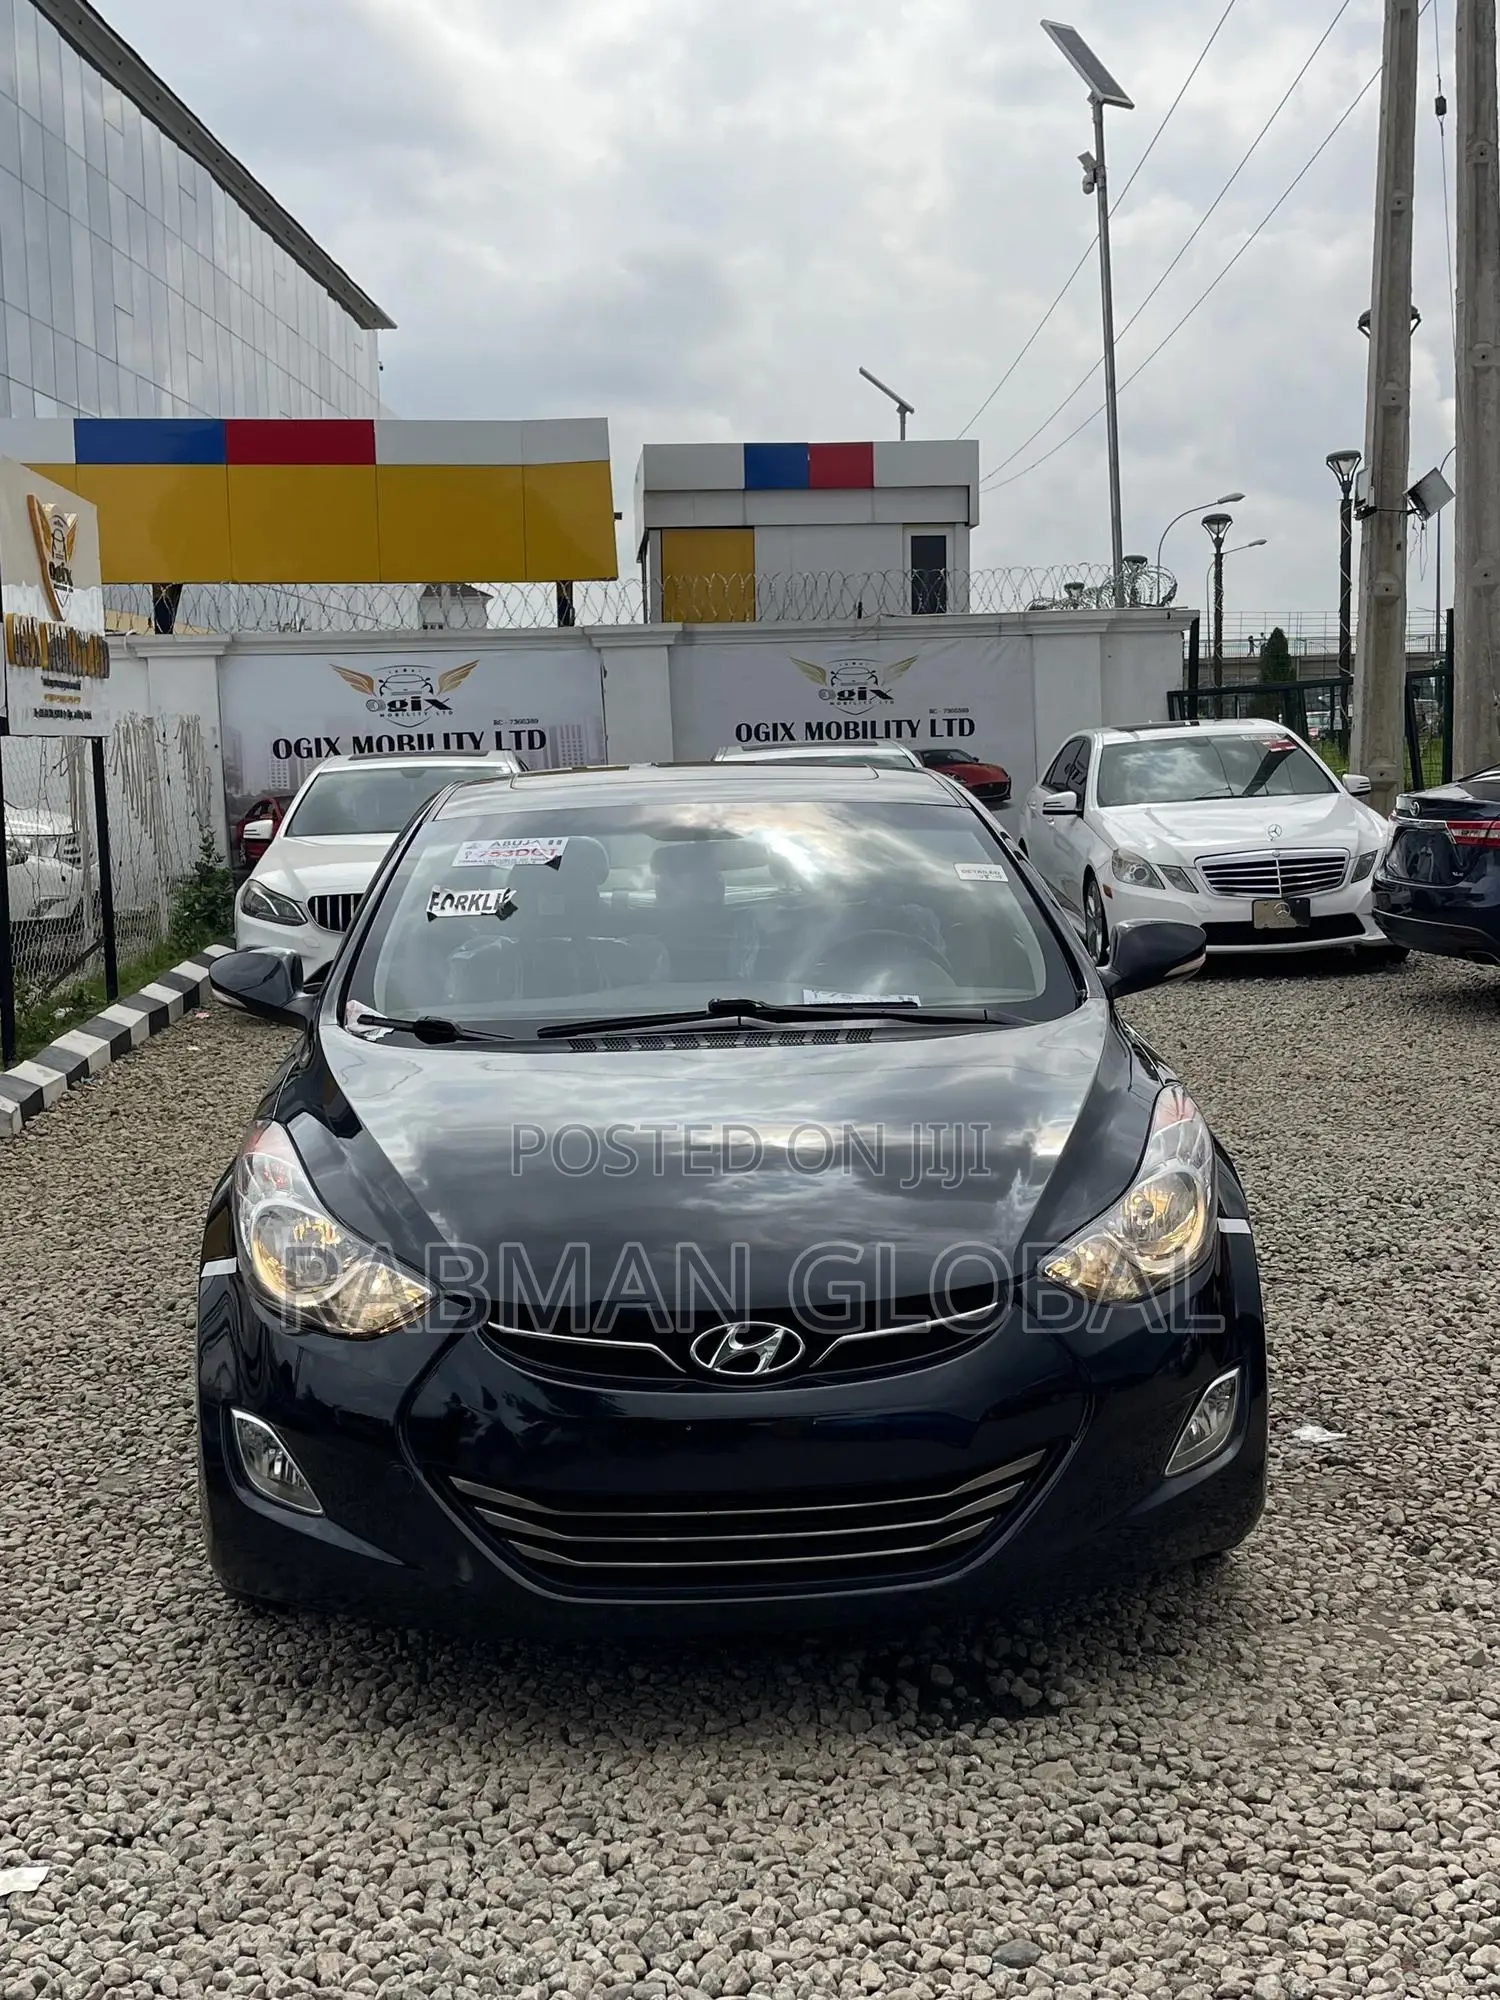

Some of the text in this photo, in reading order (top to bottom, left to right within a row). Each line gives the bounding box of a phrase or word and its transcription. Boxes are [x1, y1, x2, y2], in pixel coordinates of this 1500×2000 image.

[735, 717, 975, 743] OGIX MOBILITY LTD
[272, 729, 547, 760] OGIX MOBILITY LTD
